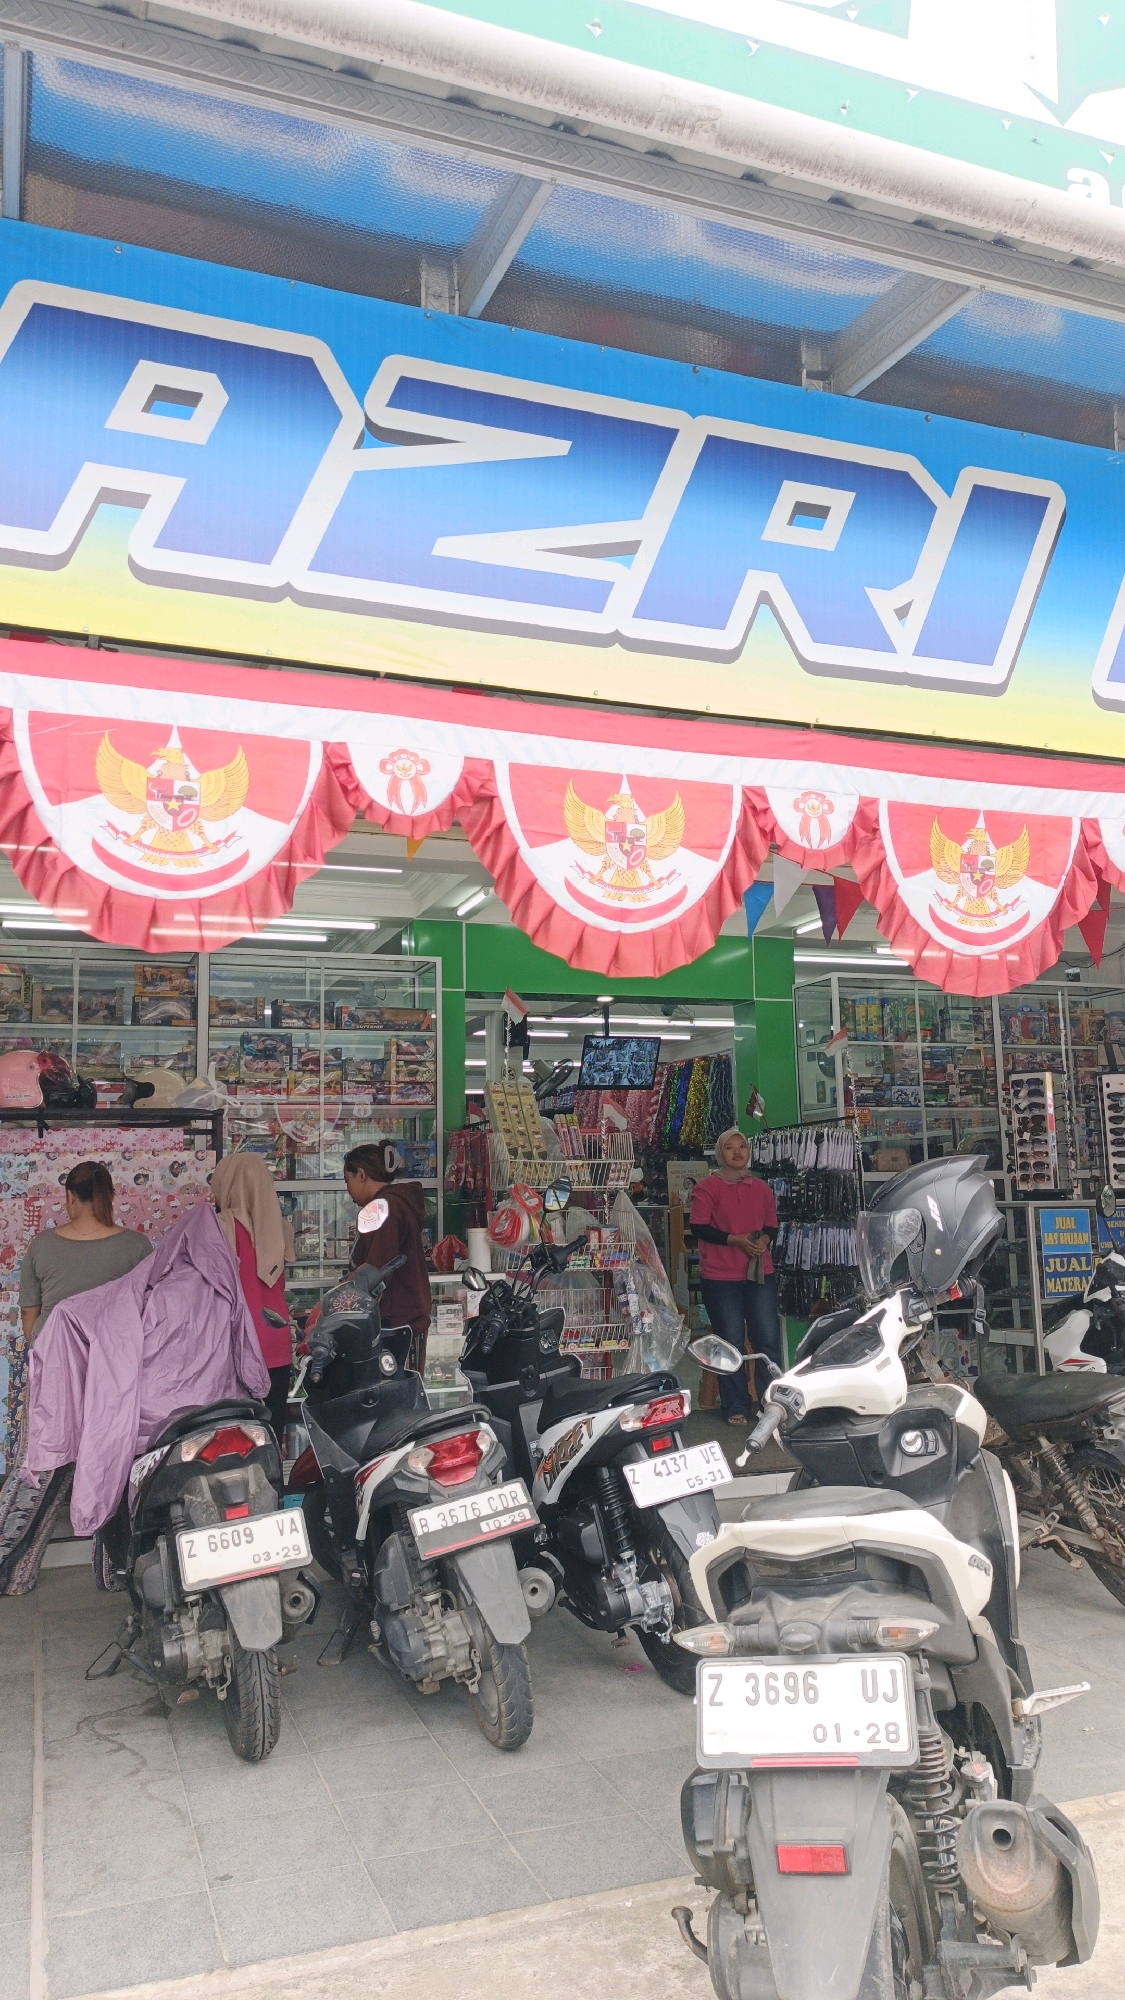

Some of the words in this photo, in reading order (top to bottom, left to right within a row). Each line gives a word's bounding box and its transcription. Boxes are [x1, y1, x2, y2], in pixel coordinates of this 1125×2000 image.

[0, 280, 1066, 697] AZRI
[1055, 1216, 1077, 1229] JUAL
[1060, 1232, 1089, 1245] HUJAN
[1045, 1257, 1091, 1272] JUAL
[628, 1468, 640, 1485] Z
[653, 1455, 689, 1478] 4137
[700, 1445, 721, 1465] VE
[418, 1517, 430, 1534] B
[437, 1501, 482, 1529] 3676
[487, 1490, 522, 1512] CDR
[185, 1539, 198, 1559] Z
[207, 1526, 255, 1553] 6609
[276, 1516, 300, 1537] VA
[708, 1673, 724, 1707] Z
[744, 1670, 820, 1707] 3696
[860, 1668, 899, 1704] UJ
